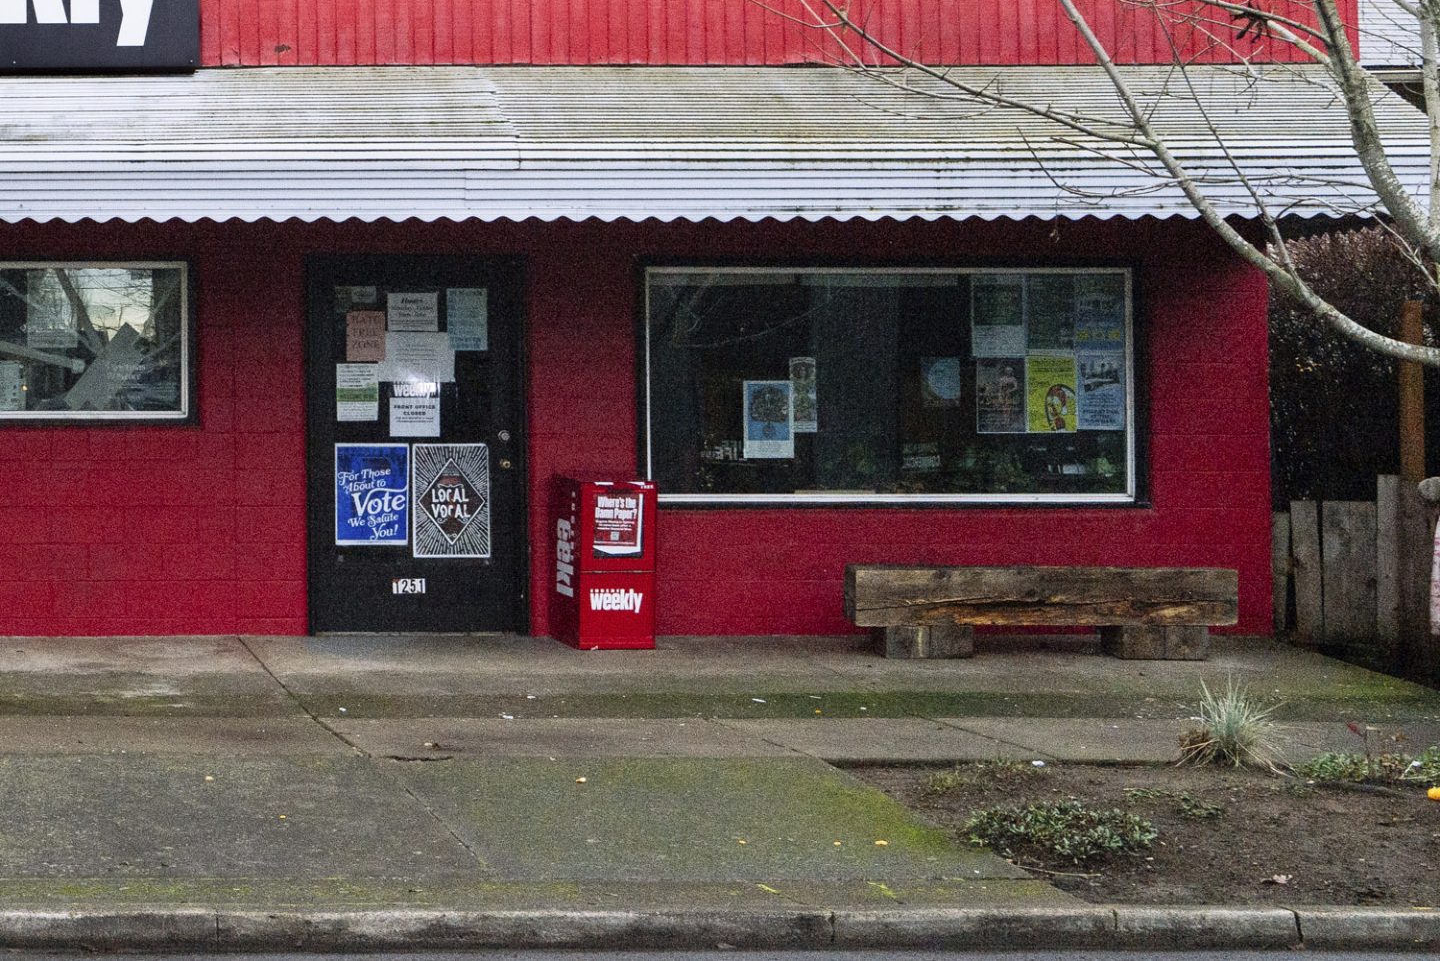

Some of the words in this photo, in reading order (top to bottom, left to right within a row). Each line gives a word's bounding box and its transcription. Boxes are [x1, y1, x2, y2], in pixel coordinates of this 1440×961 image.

[338, 471, 359, 486] For
[361, 468, 391, 482] Those
[343, 480, 374, 494] About
[377, 479, 386, 488] to
[351, 488, 407, 517] Vote
[431, 488, 469, 502] LOCAL
[431, 504, 471, 518] VOCAL
[348, 517, 366, 528] We
[368, 513, 399, 528] Salute
[370, 523, 399, 541] You!
[393, 579, 425, 594] 1251
[590, 589, 643, 613] weekly
